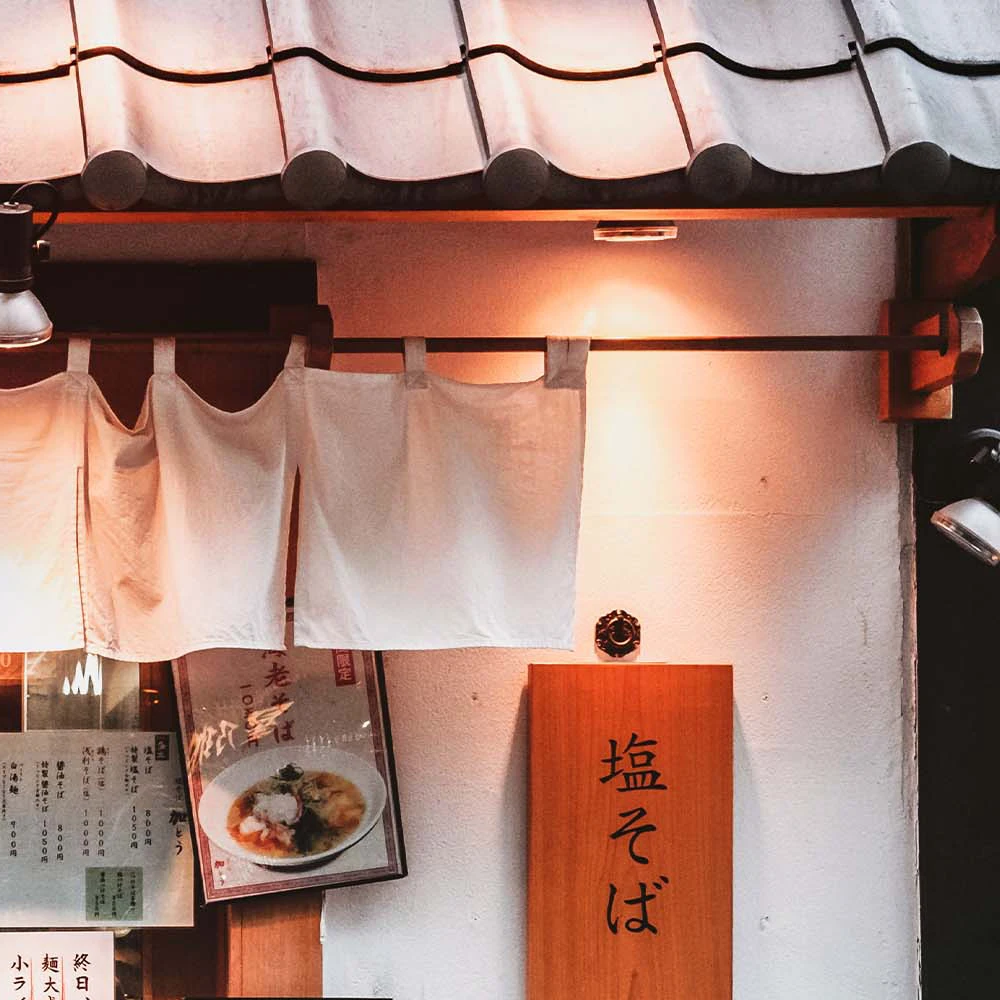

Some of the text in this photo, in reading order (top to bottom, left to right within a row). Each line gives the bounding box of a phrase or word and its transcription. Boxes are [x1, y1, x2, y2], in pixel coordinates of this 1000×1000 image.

[333, 650, 353, 681] 限定
[10, 821, 18, 857] 900円
[41, 820, 49, 863] 1050円
[56, 824, 64, 861] 800円
[82, 809, 90, 857] 1000円
[97, 809, 105, 857] 1000円
[130, 805, 138, 849] 1050円
[144, 809, 152, 846] 800円
[600, 732, 669, 935] 塩そば
